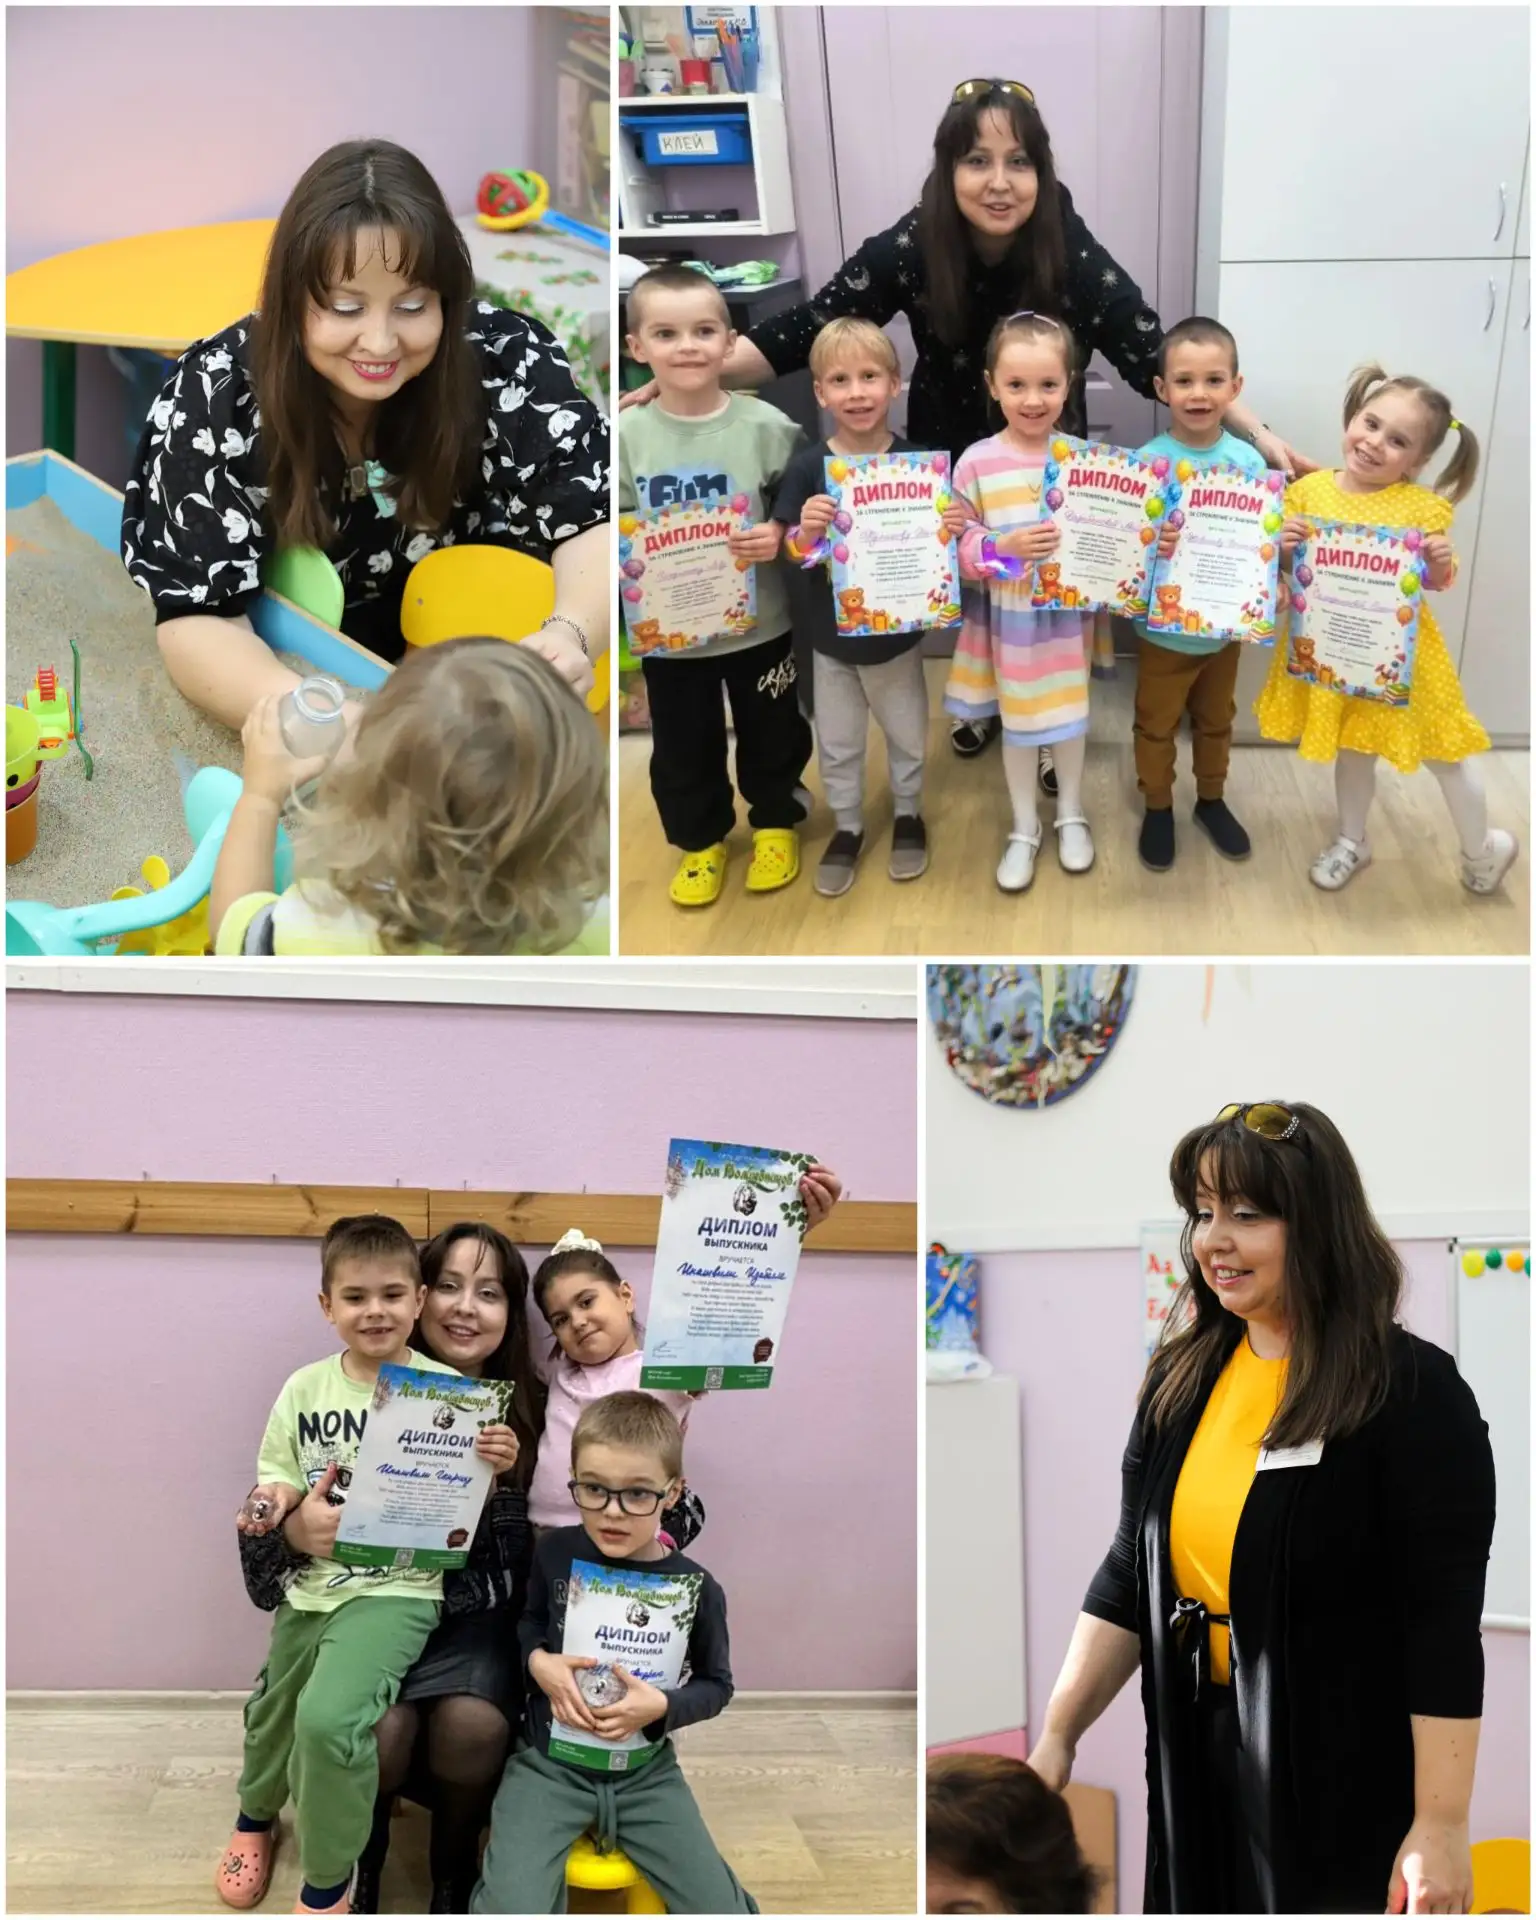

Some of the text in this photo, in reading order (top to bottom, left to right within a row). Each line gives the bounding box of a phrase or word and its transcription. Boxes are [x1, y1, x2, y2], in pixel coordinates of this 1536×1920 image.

[662, 132, 705, 151] КЛЕЙ
[1068, 468, 1147, 499] ДИПЛОМ
[853, 481, 933, 508] ДИПЛОМ
[1189, 488, 1264, 515] ДИПЛОМ
[644, 522, 731, 554] ДИПЛОМ
[1315, 546, 1400, 576] ДИПЛОМ
[697, 1216, 778, 1238] ДИПЛОМ
[704, 1238, 768, 1252] ВЫПУСКНИКА
[397, 1428, 475, 1449] ДИПЛОМ
[402, 1446, 464, 1459] ВЫПУСКНИКА
[594, 1623, 672, 1644] ДИПЛОМ
[600, 1641, 664, 1656] ВЫПУСКНИКА
